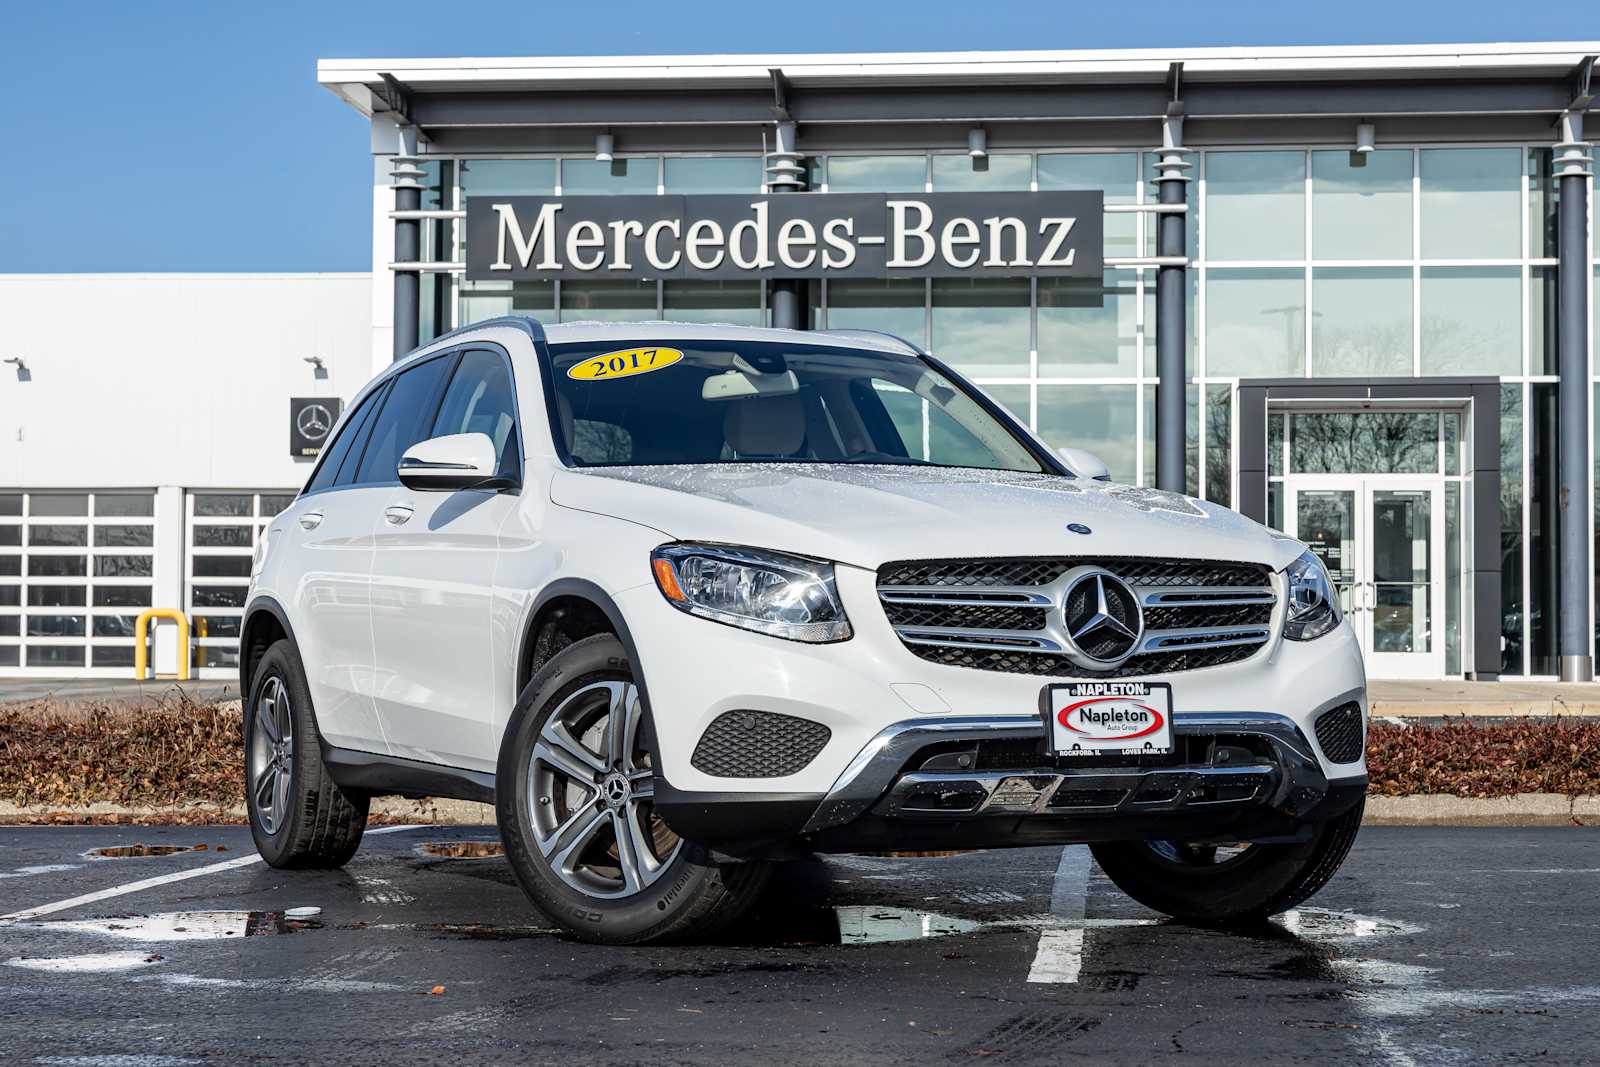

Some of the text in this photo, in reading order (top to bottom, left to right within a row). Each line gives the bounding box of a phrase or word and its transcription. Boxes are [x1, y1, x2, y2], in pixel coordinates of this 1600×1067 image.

[489, 200, 1077, 271] Mercedes-Benz
[591, 350, 657, 376] 2017
[1077, 683, 1144, 695] NAPLETON
[1080, 708, 1148, 725] Napleton
[1122, 724, 1138, 732] Group
